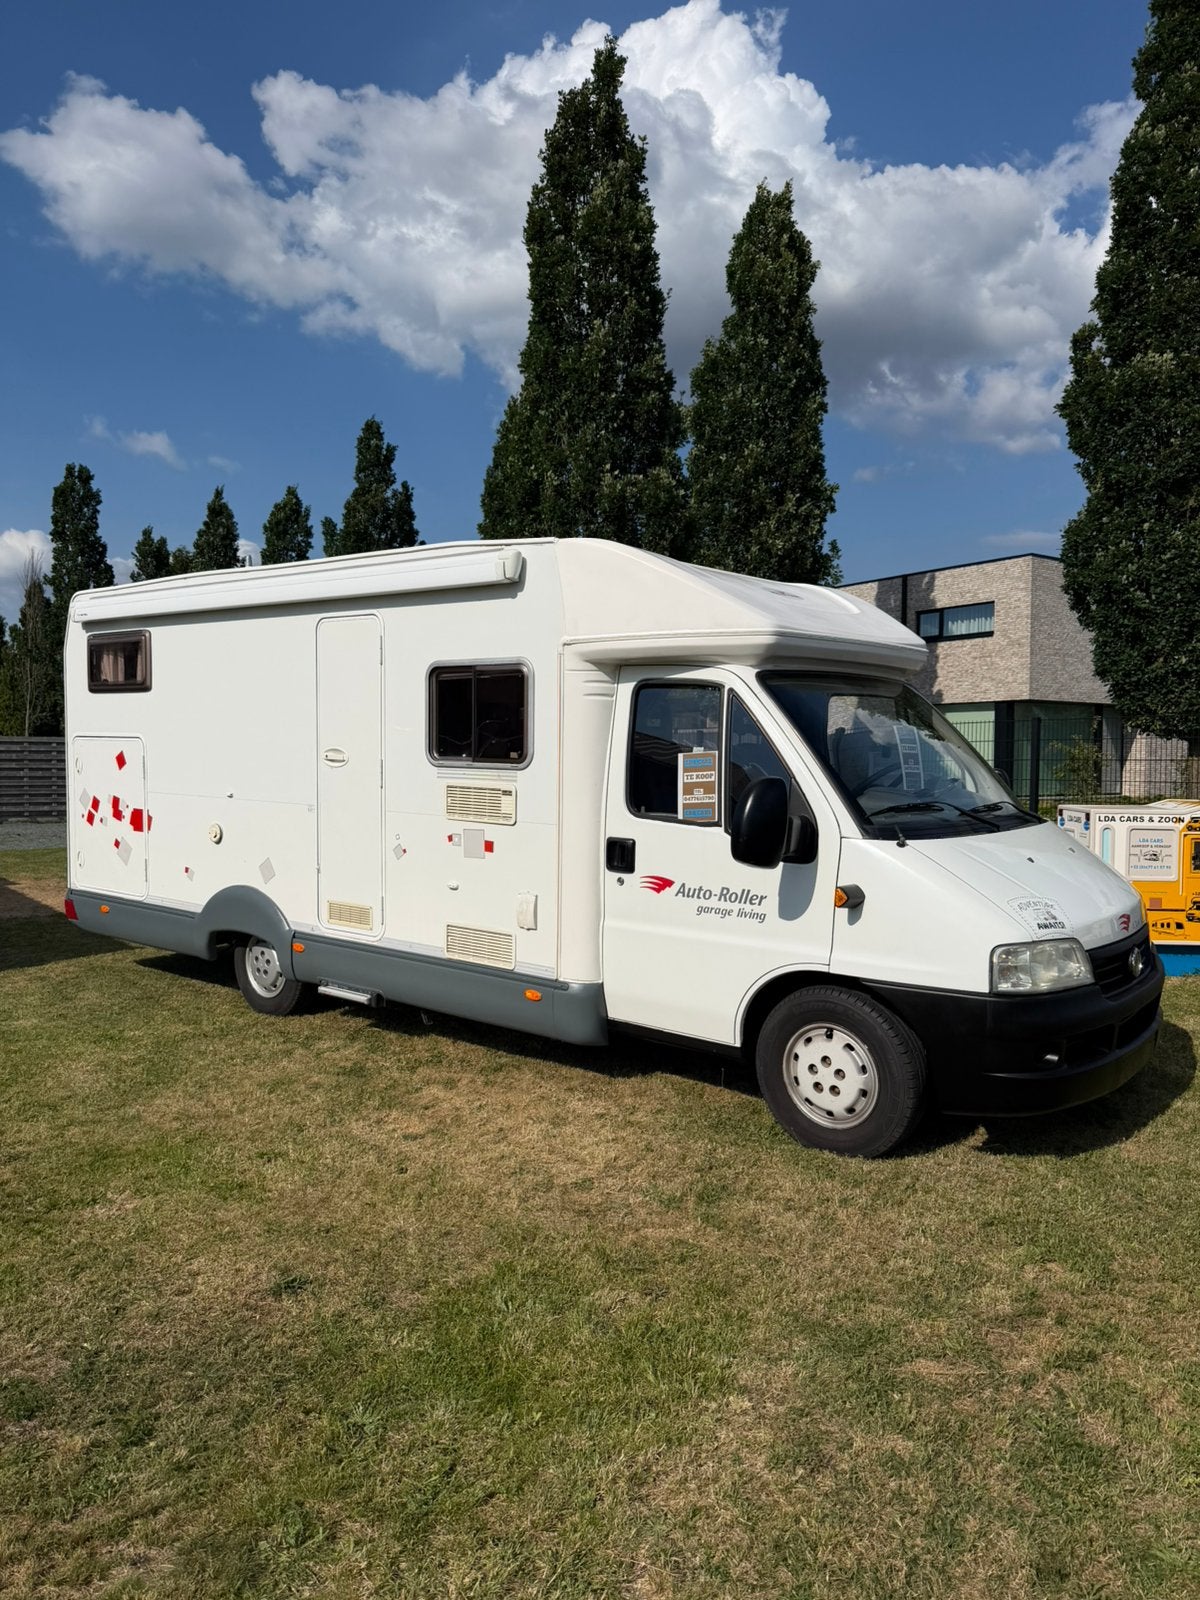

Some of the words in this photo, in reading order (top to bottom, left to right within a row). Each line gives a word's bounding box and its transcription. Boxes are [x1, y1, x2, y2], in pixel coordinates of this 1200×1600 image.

[1098, 815, 1116, 823] LDA
[1119, 815, 1145, 823] CARS
[1157, 816, 1185, 824] ZOON
[675, 882, 767, 906] Auto-Roller
[696, 905, 734, 919] garage
[736, 907, 767, 924] living
